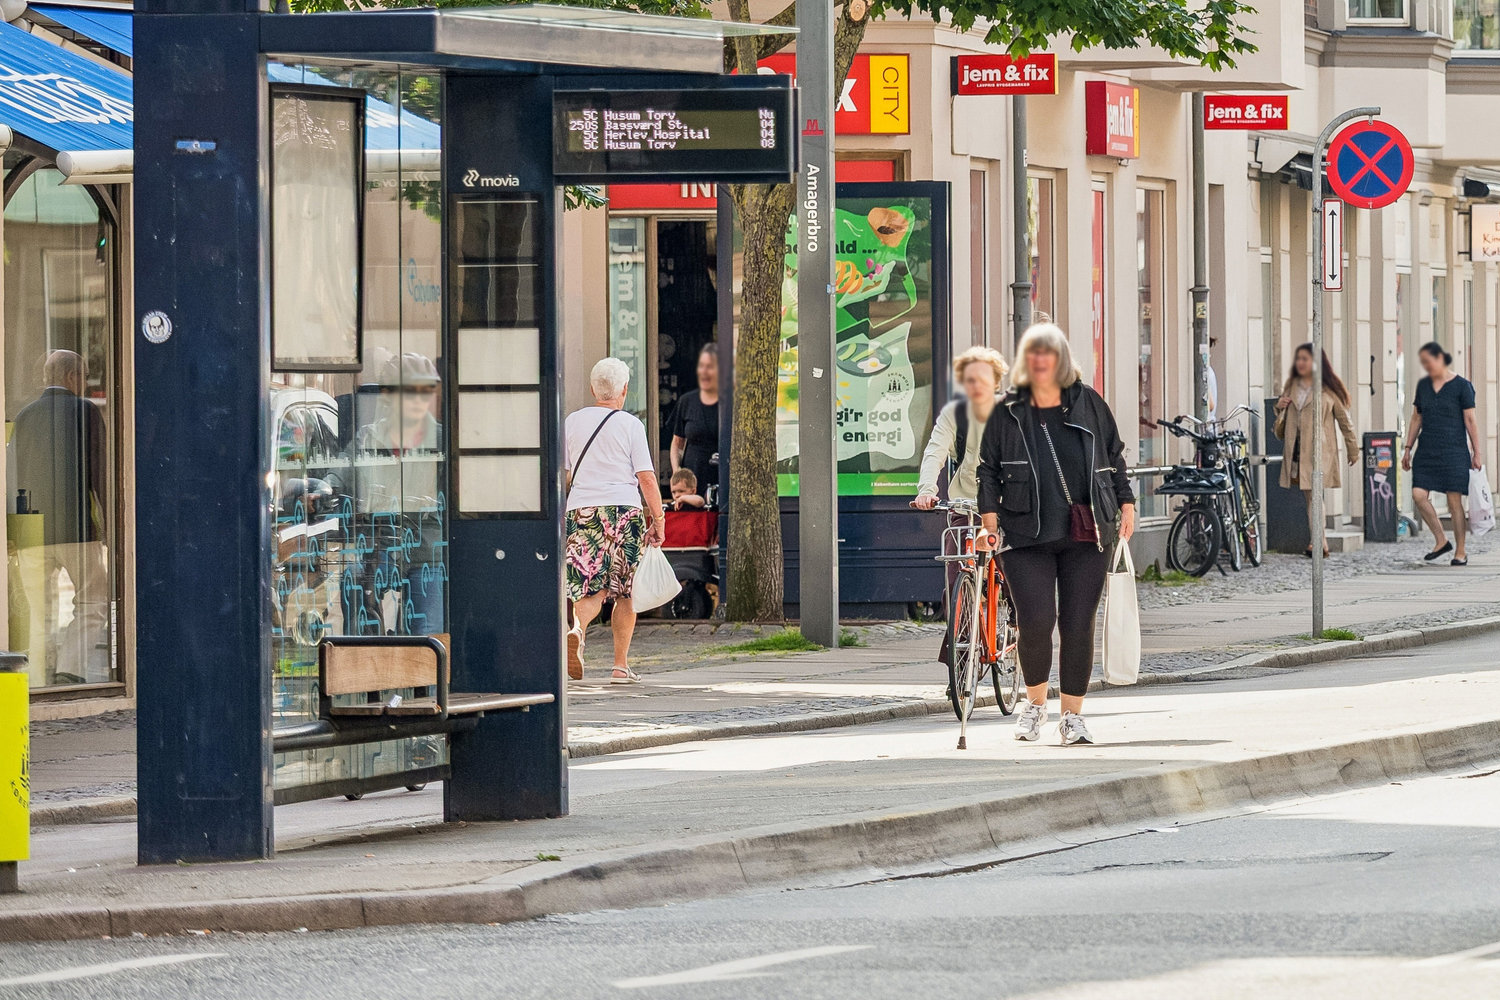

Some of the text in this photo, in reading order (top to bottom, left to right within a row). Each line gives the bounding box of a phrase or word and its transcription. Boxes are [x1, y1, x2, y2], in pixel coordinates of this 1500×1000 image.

[962, 64, 1050, 86] jem & fix
[883, 67, 899, 122] CITY
[583, 109, 774, 121] 5C Husum Torv Nu
[1208, 104, 1283, 122] jem & fix
[570, 120, 774, 131] 250S Bagsværd St. 04
[583, 129, 774, 140] 5C Herlev Hospital 04
[583, 139, 775, 150] 5C Husum Torv 08
[480, 174, 520, 187] movia
[804, 164, 821, 252] Amagerbro
[868, 408, 902, 426] god
[843, 428, 902, 447] energi
